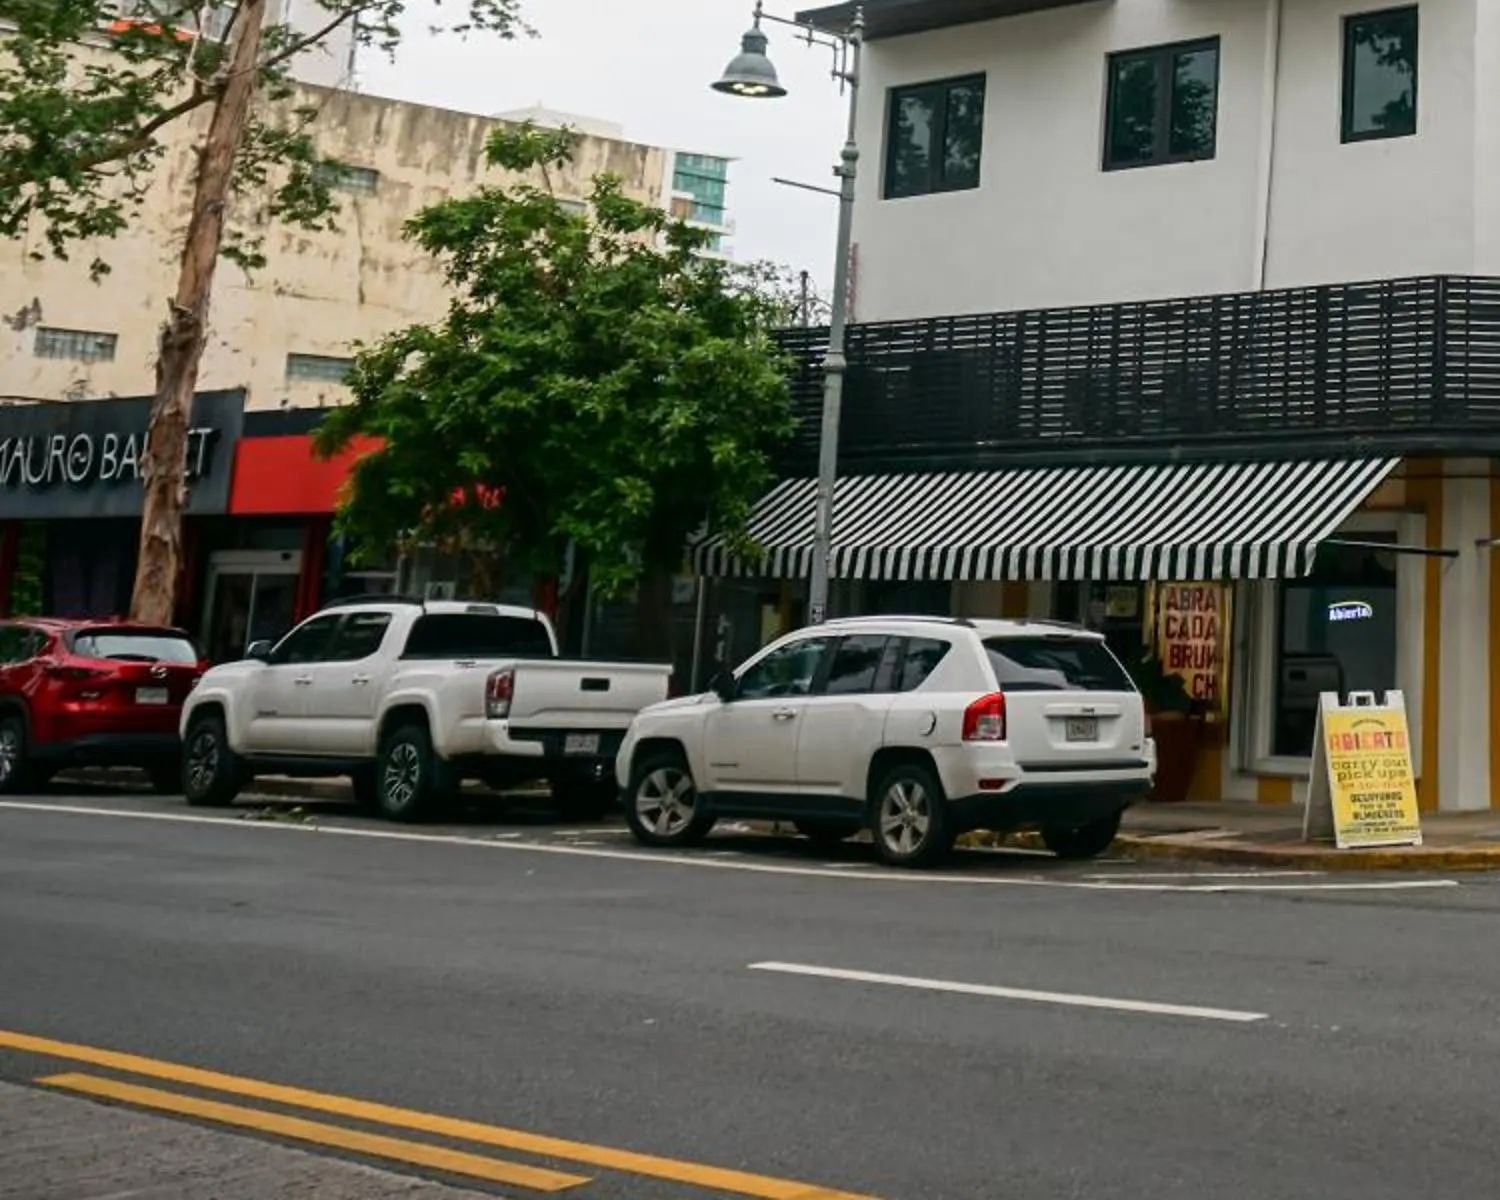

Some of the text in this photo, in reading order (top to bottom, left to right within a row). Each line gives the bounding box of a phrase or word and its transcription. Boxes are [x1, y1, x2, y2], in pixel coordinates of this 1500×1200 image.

[100, 428, 212, 479] BAT
[1166, 587, 1216, 610] ABRA
[1166, 615, 1216, 639] CADA
[1192, 673, 1217, 699] CH
[1329, 731, 1406, 751] ABIERTO
[1331, 758, 1408, 771] carry out
[1337, 770, 1372, 782] pick
